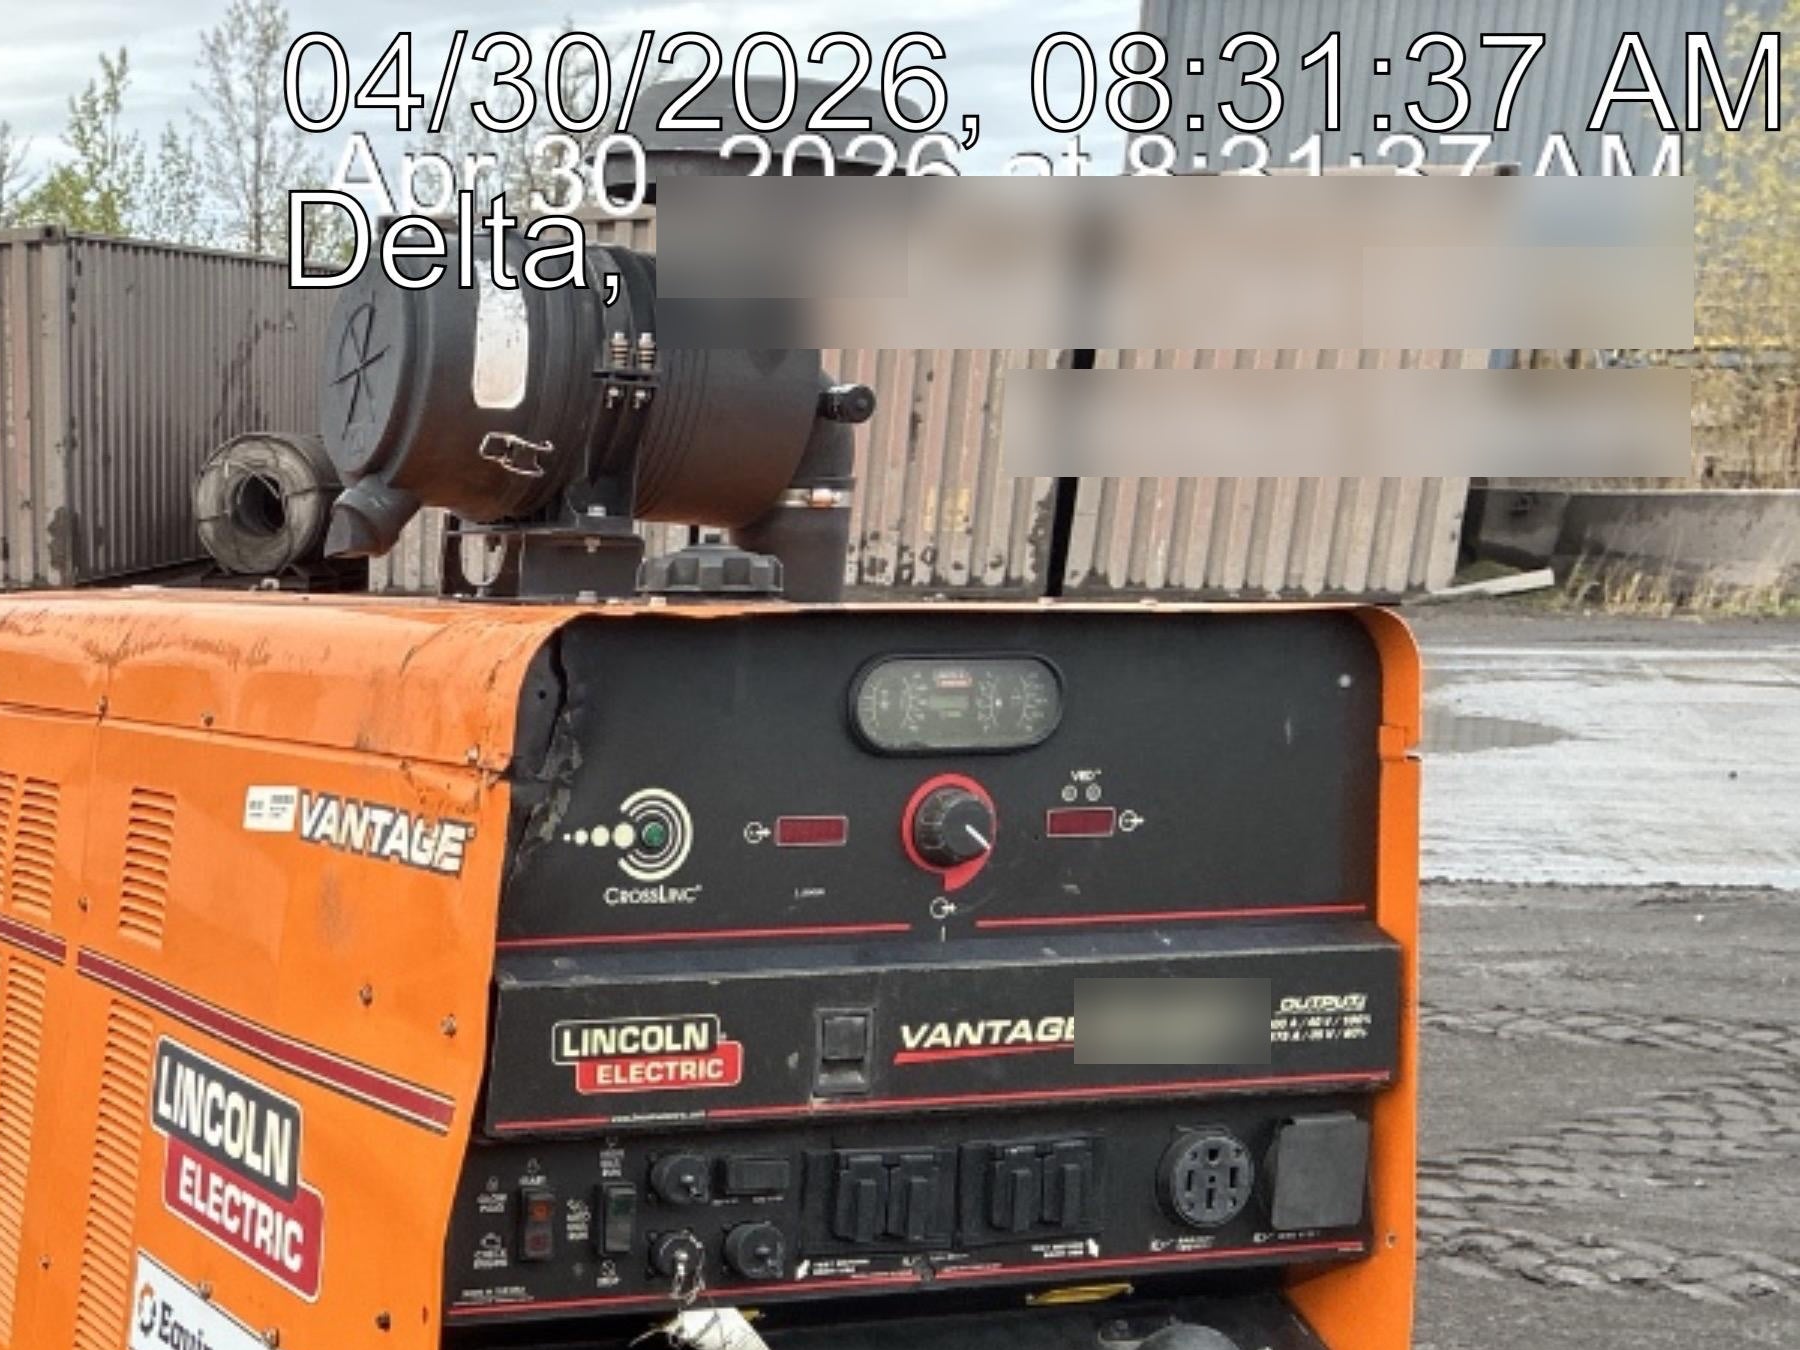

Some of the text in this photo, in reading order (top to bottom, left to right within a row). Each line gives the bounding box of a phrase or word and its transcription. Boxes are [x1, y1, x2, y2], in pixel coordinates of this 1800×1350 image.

[302, 793, 467, 872] VANTAGE
[562, 1022, 709, 1057] LINCOLN
[596, 1058, 725, 1085] ELECTRIC
[157, 1055, 292, 1187] LINCOLN
[178, 1155, 304, 1273] ELECTRIC
